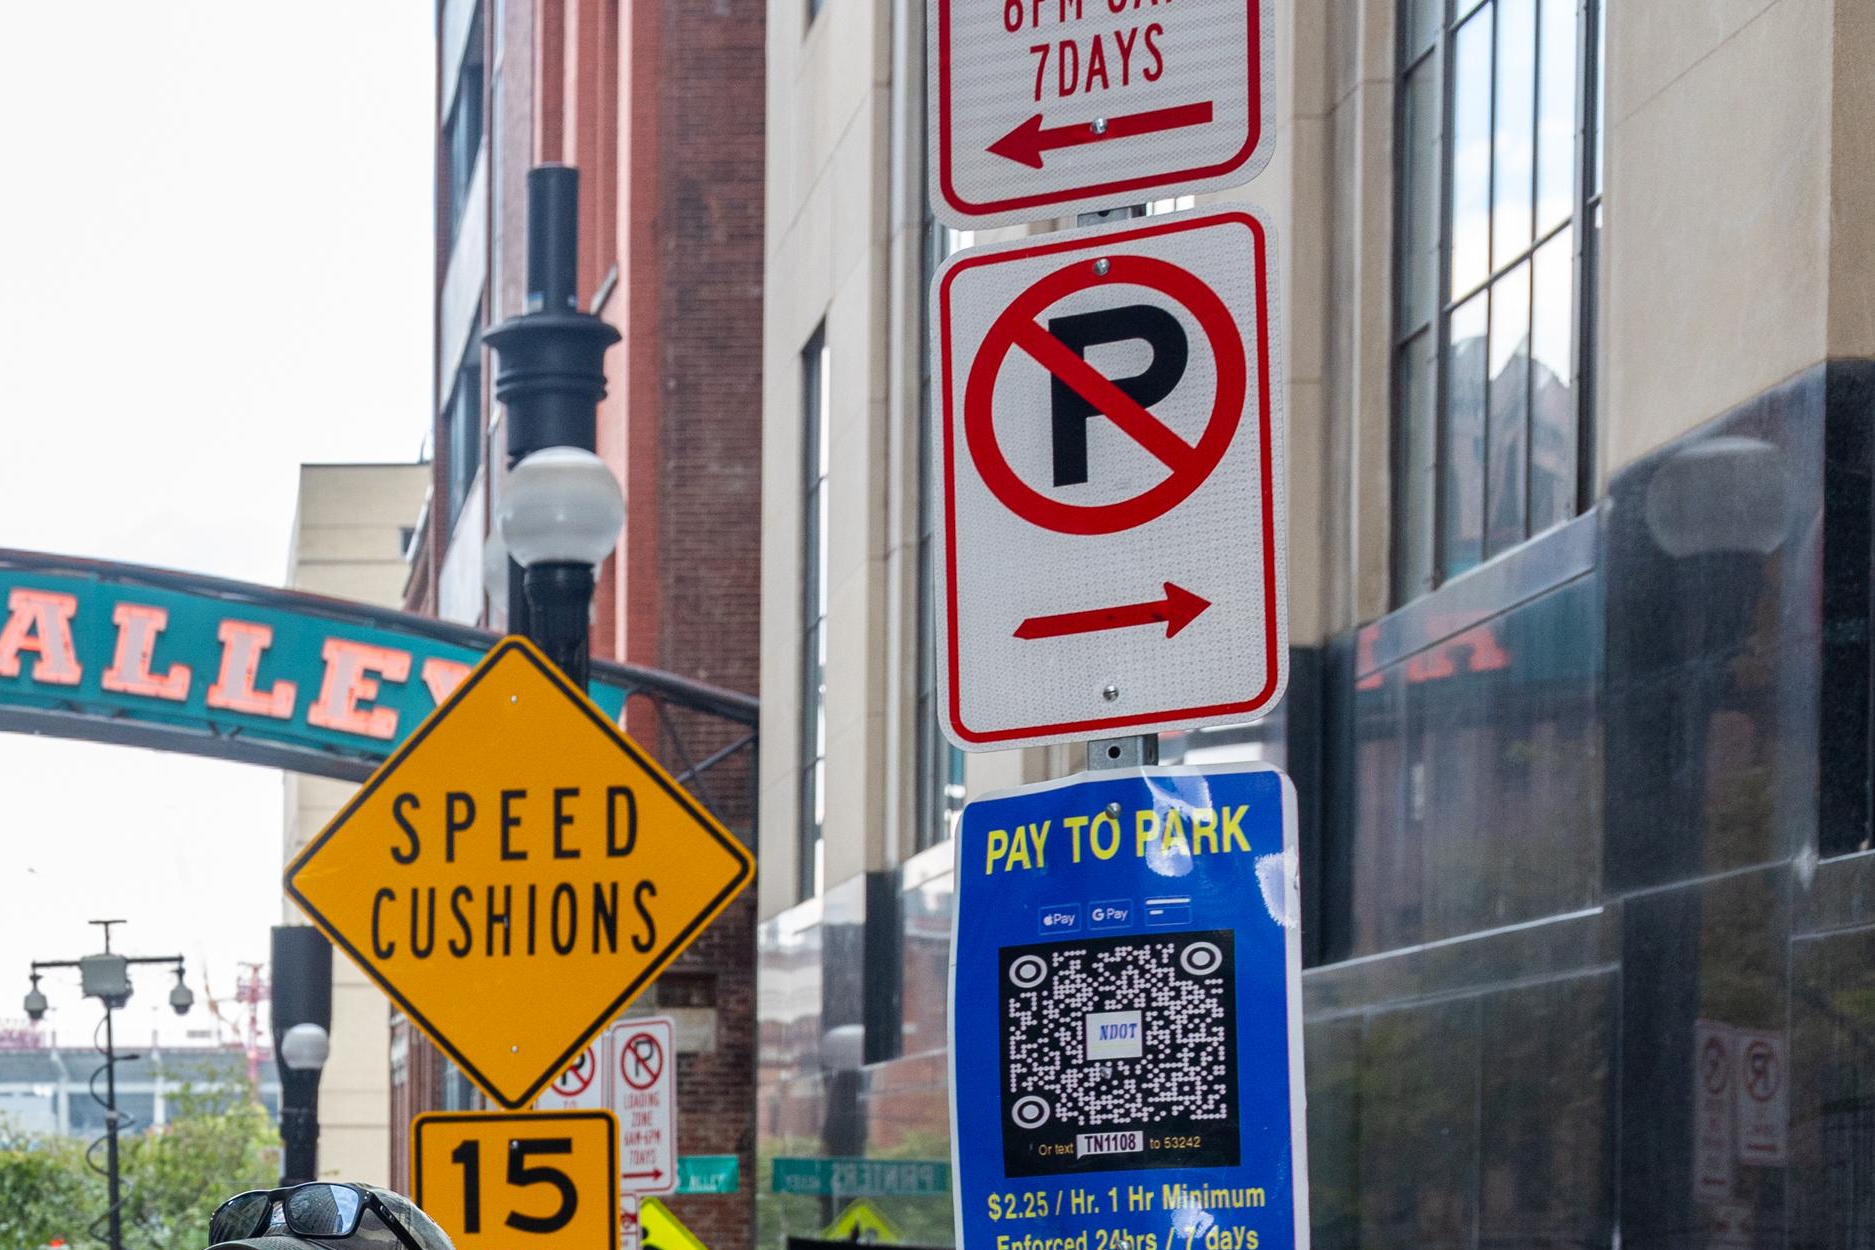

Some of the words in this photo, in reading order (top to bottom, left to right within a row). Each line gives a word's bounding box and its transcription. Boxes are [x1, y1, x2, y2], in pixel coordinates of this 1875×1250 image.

[1029, 22, 1164, 102] 7DAYS
[390, 785, 638, 865] SPEED
[985, 819, 1051, 876] PAY
[1063, 811, 1121, 864] TO
[1135, 804, 1252, 858] PARK
[371, 879, 658, 960] CUSHIONS
[1099, 1022, 1138, 1041] NDOT
[1084, 1133, 1137, 1153] TN1108
[1149, 1138, 1161, 1149] to
[1163, 1136, 1202, 1149] 53242
[451, 1137, 579, 1234] 15
[987, 1191, 1049, 1223] $2.25
[1071, 1189, 1100, 1214] Hr.
[1108, 1187, 1118, 1213] 1
[1128, 1185, 1154, 1212] Hr
[1161, 1183, 1266, 1210] Minimum
